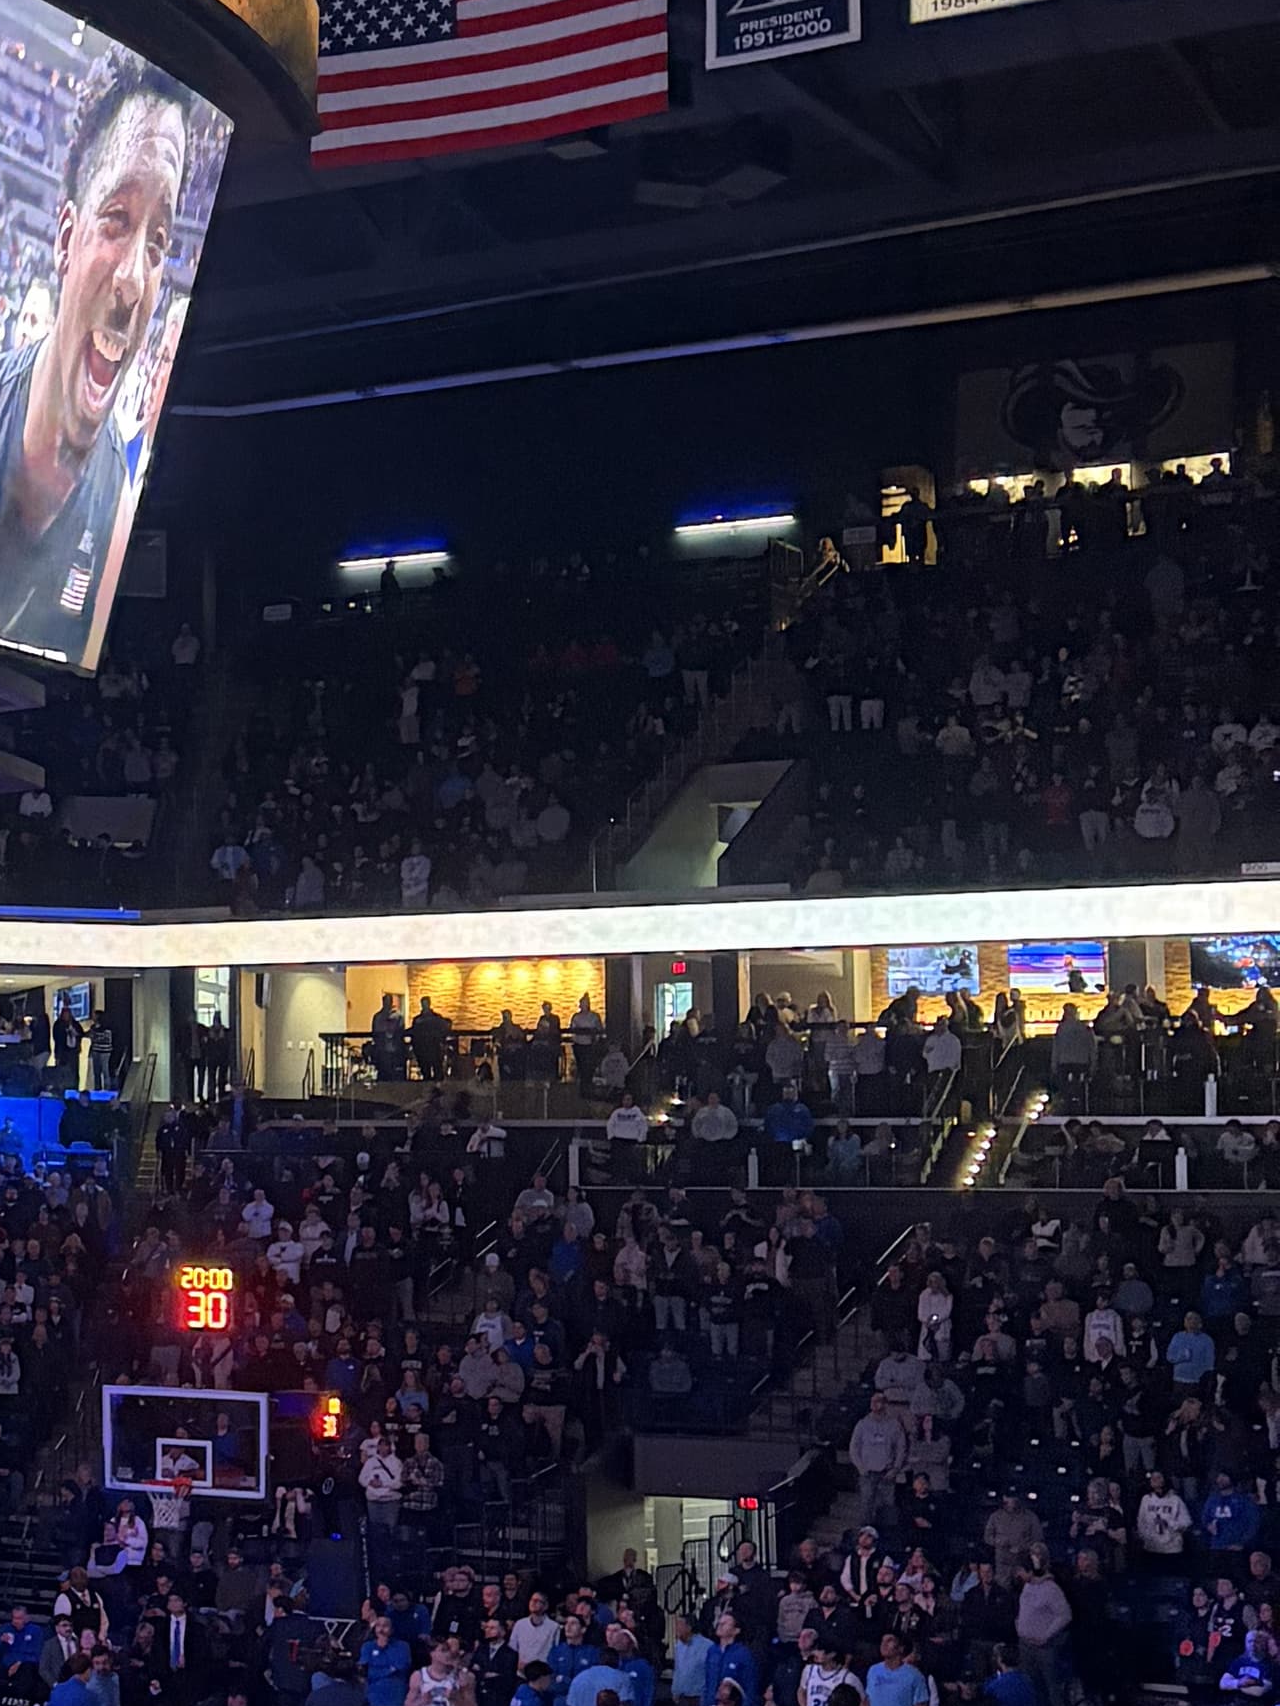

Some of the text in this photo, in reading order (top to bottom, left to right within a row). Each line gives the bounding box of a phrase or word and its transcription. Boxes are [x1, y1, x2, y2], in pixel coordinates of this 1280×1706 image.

[733, 17, 833, 51] 1991-2000
[739, 7, 825, 34] PRESIDENT
[181, 1266, 233, 1291] 20:00
[187, 1291, 228, 1329] 30
